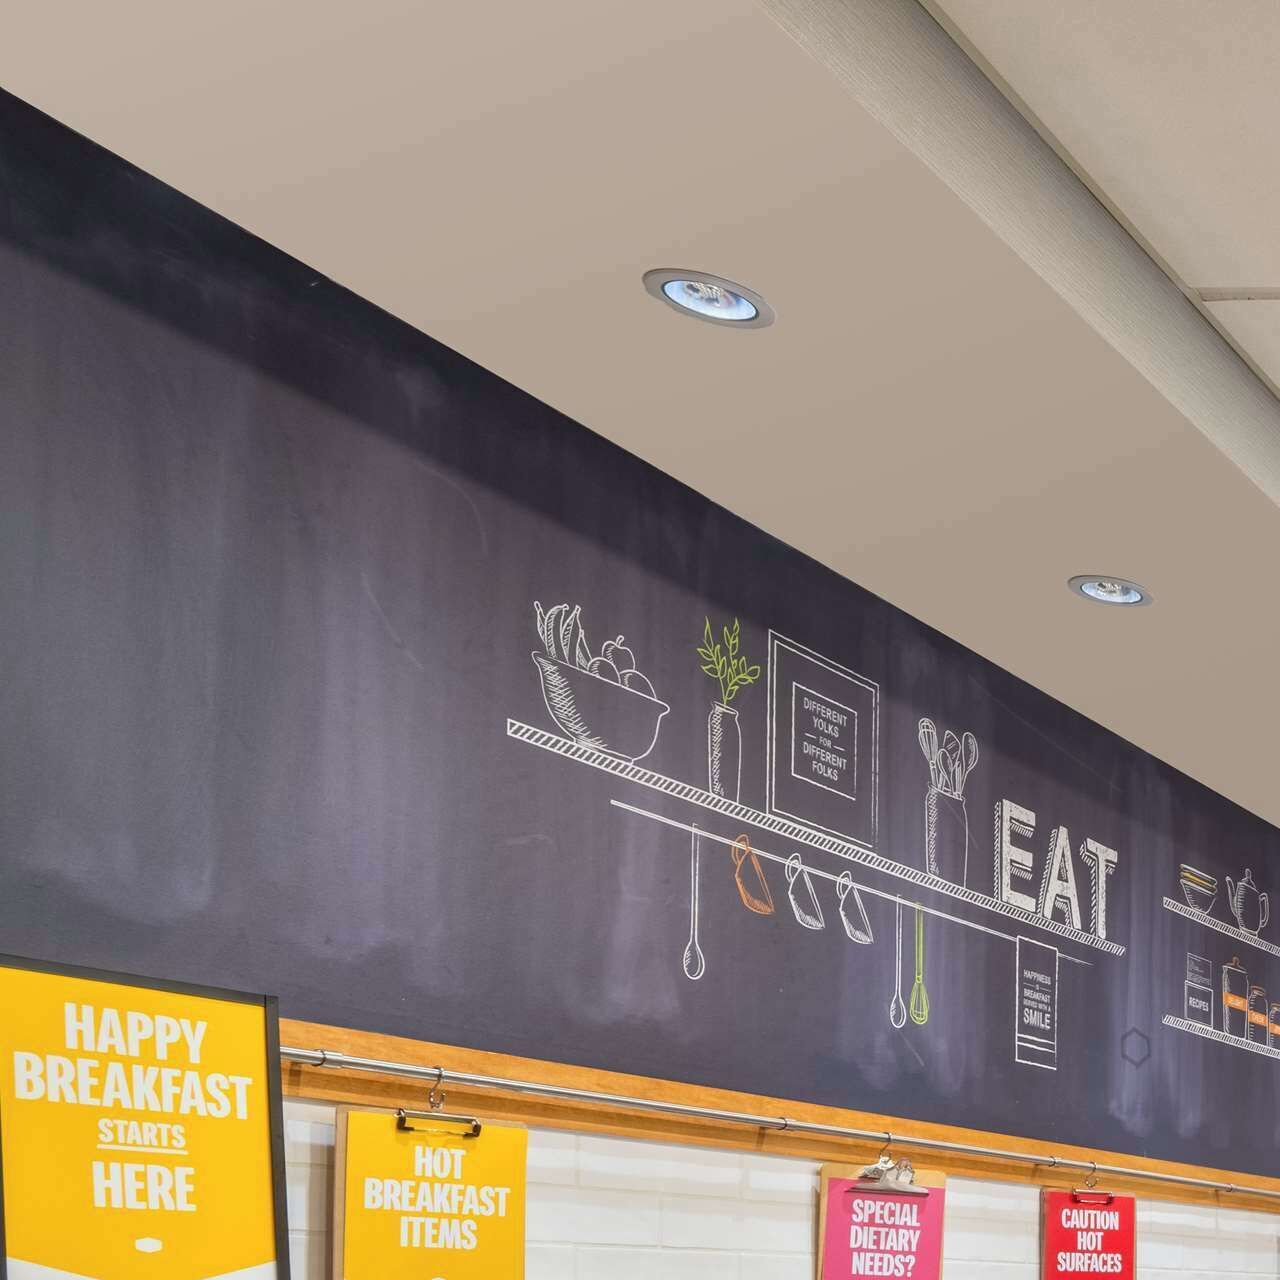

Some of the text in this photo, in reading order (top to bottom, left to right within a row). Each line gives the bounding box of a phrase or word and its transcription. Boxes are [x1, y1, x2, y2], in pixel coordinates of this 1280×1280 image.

[803, 697, 848, 727] DIFFERENT
[813, 716, 839, 738] YOLKS
[803, 741, 847, 770] DIFFERENT
[819, 736, 832, 748] FOR
[812, 761, 838, 781] FOLKS
[994, 799, 1118, 940] EAT
[1023, 969, 1051, 985] HAPPINESS
[1023, 988, 1051, 1003] BREAKFAST
[1188, 996, 1209, 1012] RECIPES
[1023, 1008, 1051, 1030] SMILE
[64, 1002, 208, 1064] HAPPY
[13, 1051, 253, 1120] BREAKFAST
[98, 1118, 187, 1148] STARTS
[414, 1145, 467, 1180] HOT
[92, 1161, 197, 1212] HERE
[364, 1177, 511, 1217] BREAKFAST
[852, 1199, 921, 1227] SPECIAL
[1061, 1208, 1119, 1230] CAUTION
[400, 1216, 478, 1250] ITEMS
[850, 1225, 921, 1252] DIETARY
[1077, 1231, 1104, 1251] HOT
[852, 1252, 916, 1277] NEEDS?
[1057, 1252, 1122, 1273] SURFACES
